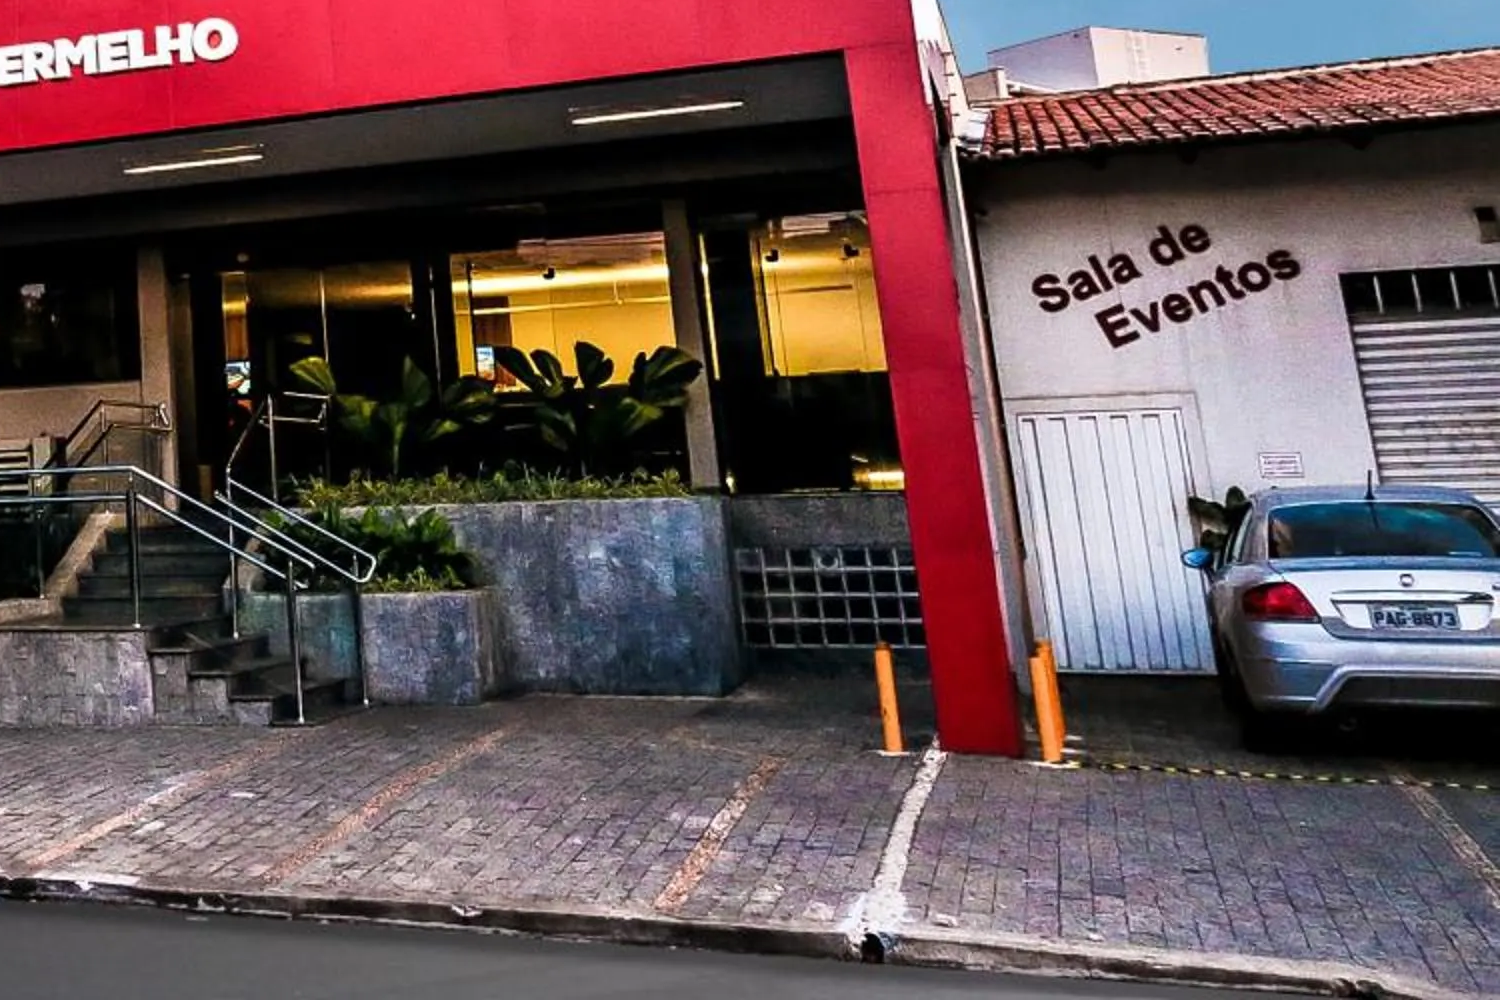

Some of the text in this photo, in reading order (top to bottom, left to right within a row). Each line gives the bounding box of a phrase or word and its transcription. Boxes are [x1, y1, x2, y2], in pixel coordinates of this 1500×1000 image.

[1031, 223, 1211, 312] Sala de
[1095, 248, 1302, 348] Eventos
